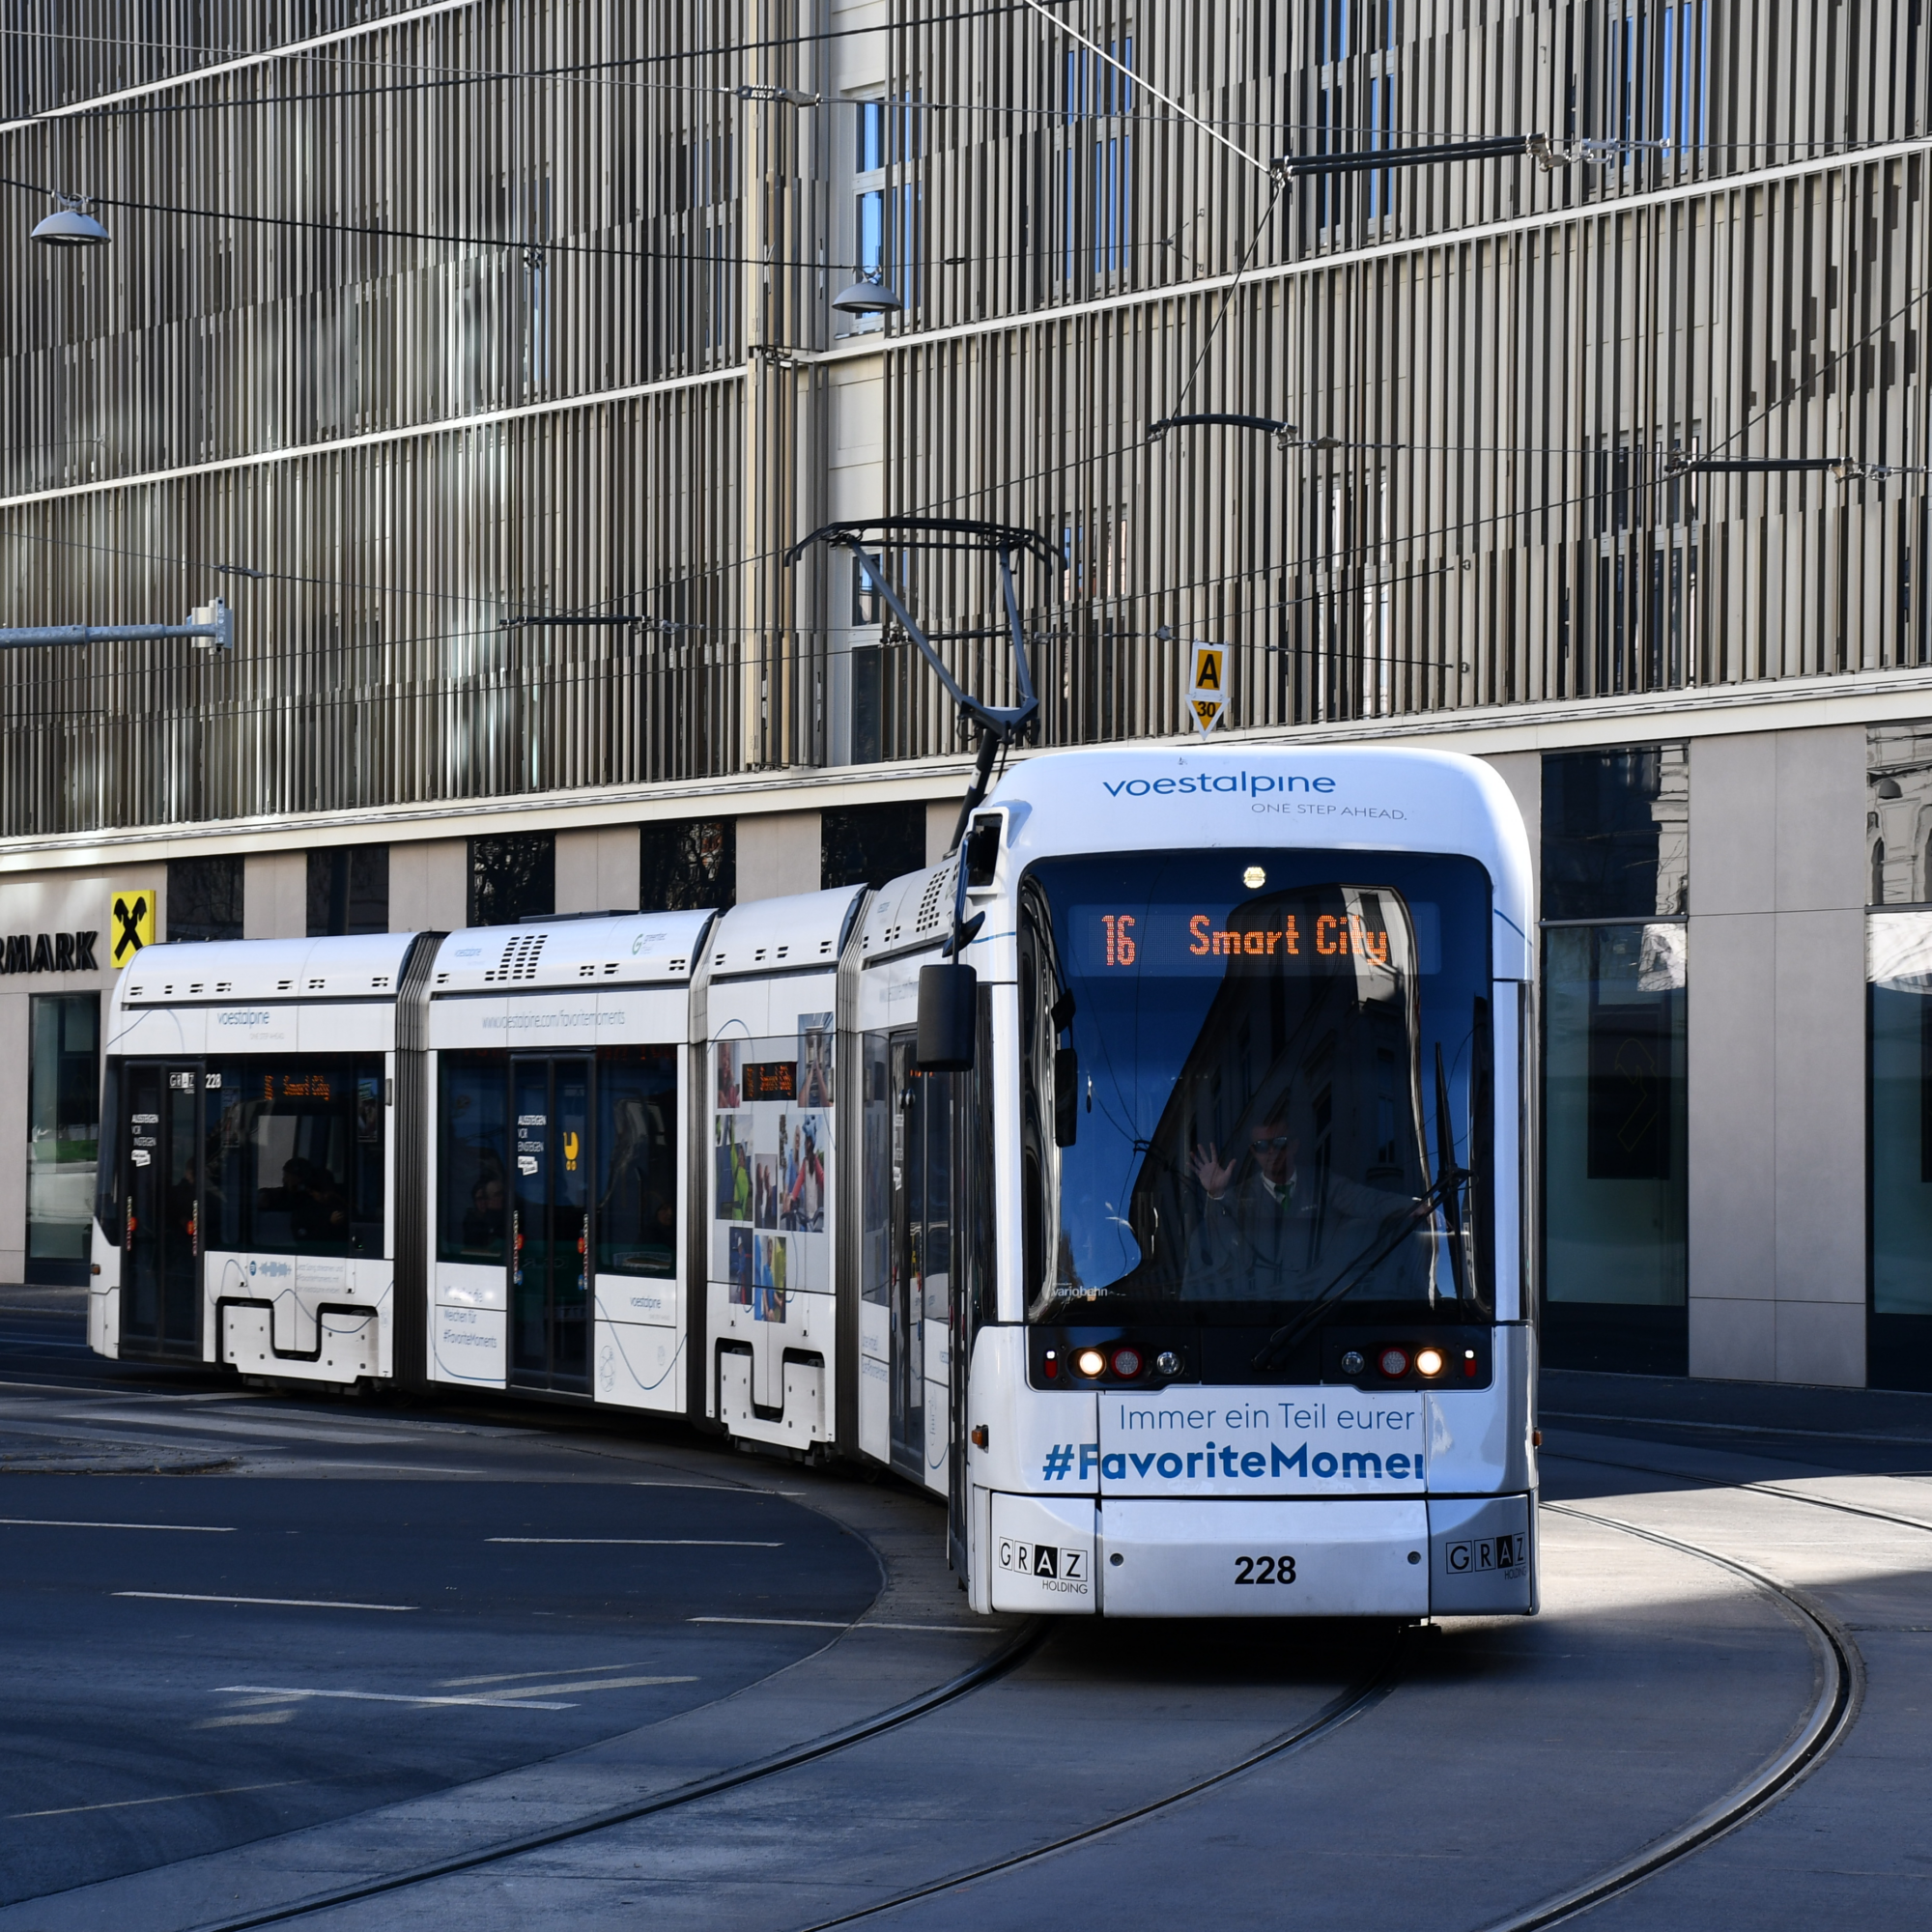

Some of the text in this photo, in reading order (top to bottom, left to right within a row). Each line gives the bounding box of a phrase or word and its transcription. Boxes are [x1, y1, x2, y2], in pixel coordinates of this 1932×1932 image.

[1197, 653, 1219, 689] A
[1197, 700, 1216, 719] 30
[1102, 770, 1337, 798] voestalpine
[1251, 802, 1407, 821] ONE STEP AHEAD.
[1101, 914, 1388, 966] 16 Smart City
[217, 1008, 270, 1029] voestalpine
[206, 1073, 222, 1089] 228
[517, 1127, 528, 1139] VOR
[1052, 1286, 1108, 1297] variobahn
[1120, 1403, 1415, 1431] Immer ein Teil eurer
[999, 1537, 1088, 1582] GRAZ
[1447, 1533, 1525, 1574] GRAZ
[1235, 1556, 1296, 1585] 228
[1504, 1566, 1527, 1580] HOLDING
[1042, 1579, 1088, 1595] HOLDING
